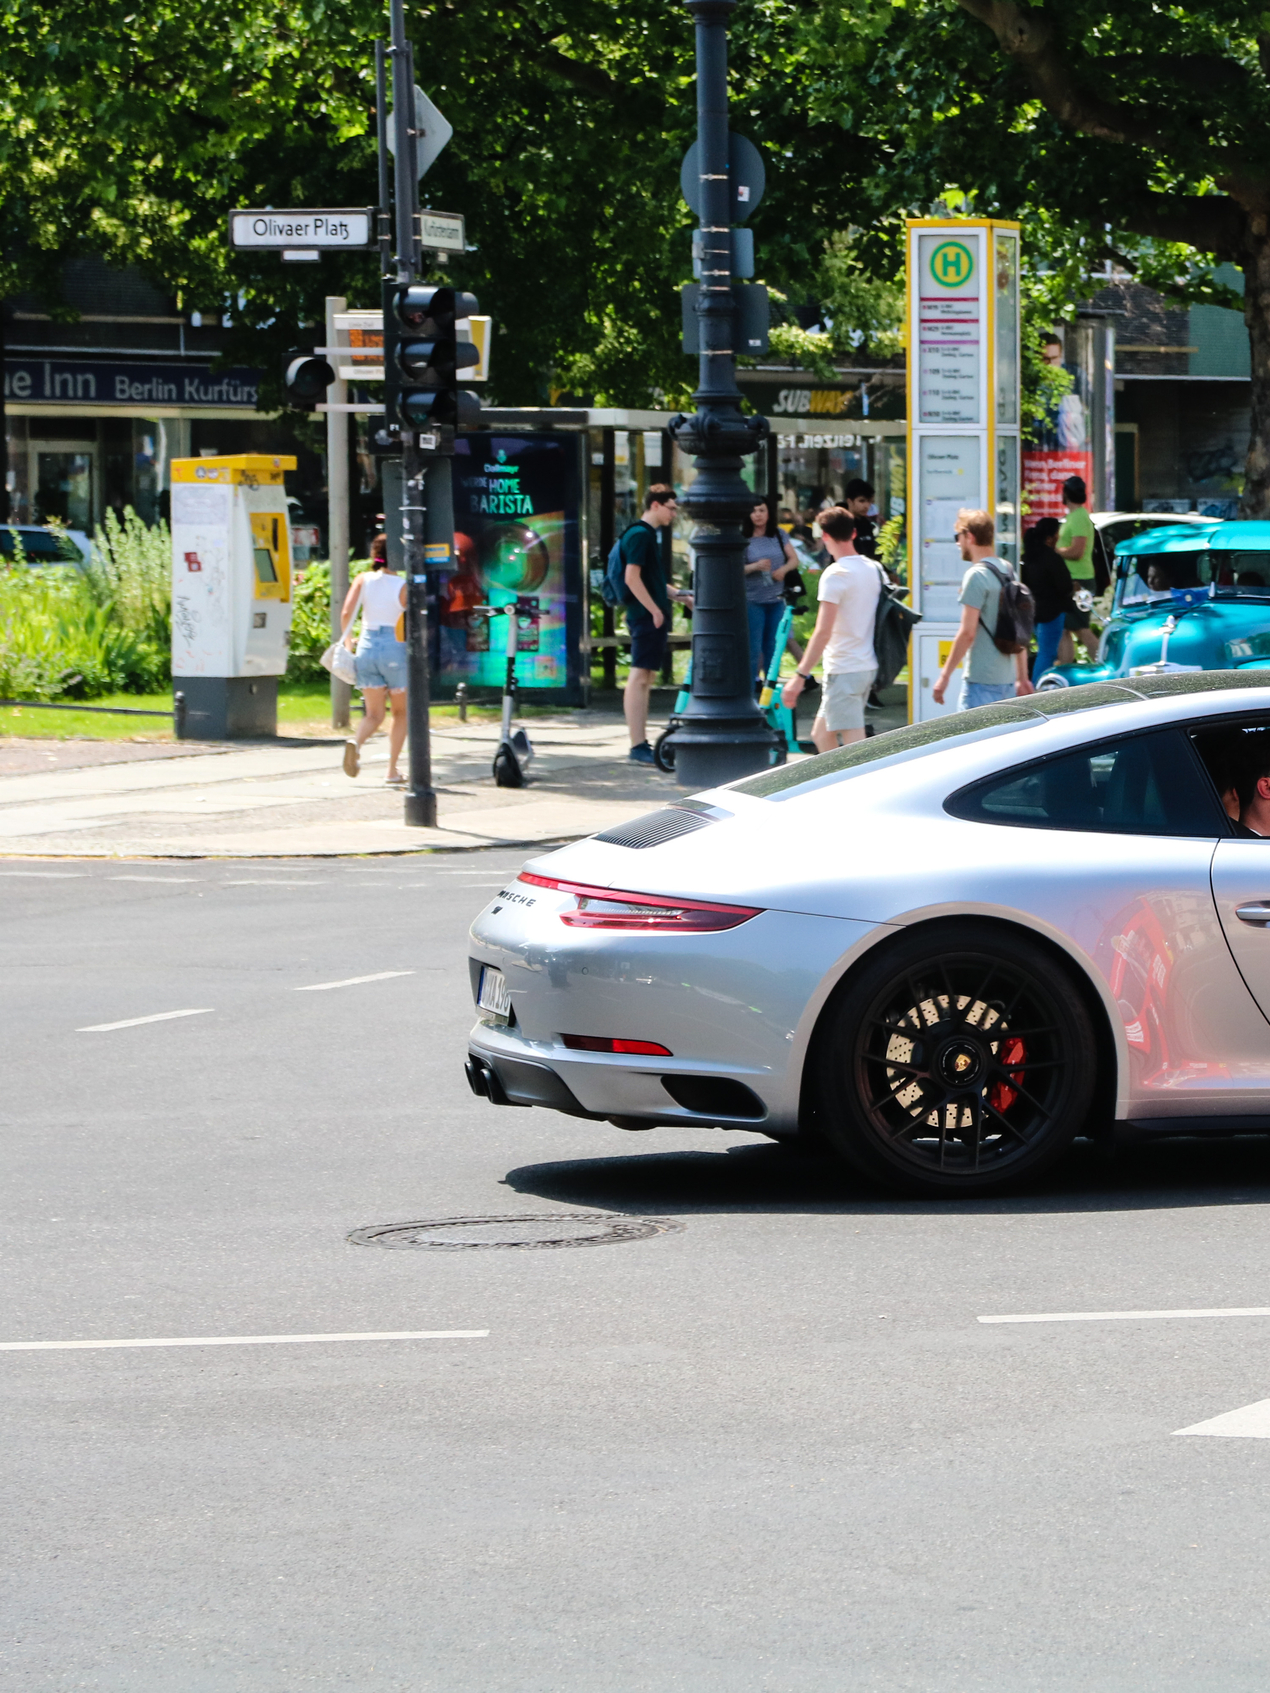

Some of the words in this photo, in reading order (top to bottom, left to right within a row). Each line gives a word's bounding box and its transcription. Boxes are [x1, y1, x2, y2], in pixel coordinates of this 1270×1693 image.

[253, 219, 310, 237] Olivaer
[314, 218, 350, 240] Platz
[44, 362, 96, 398] Inn
[115, 375, 177, 400] Berlin
[772, 389, 854, 414] SUBWAY
[489, 478, 520, 493] HOME
[470, 495, 534, 514] BARISTA
